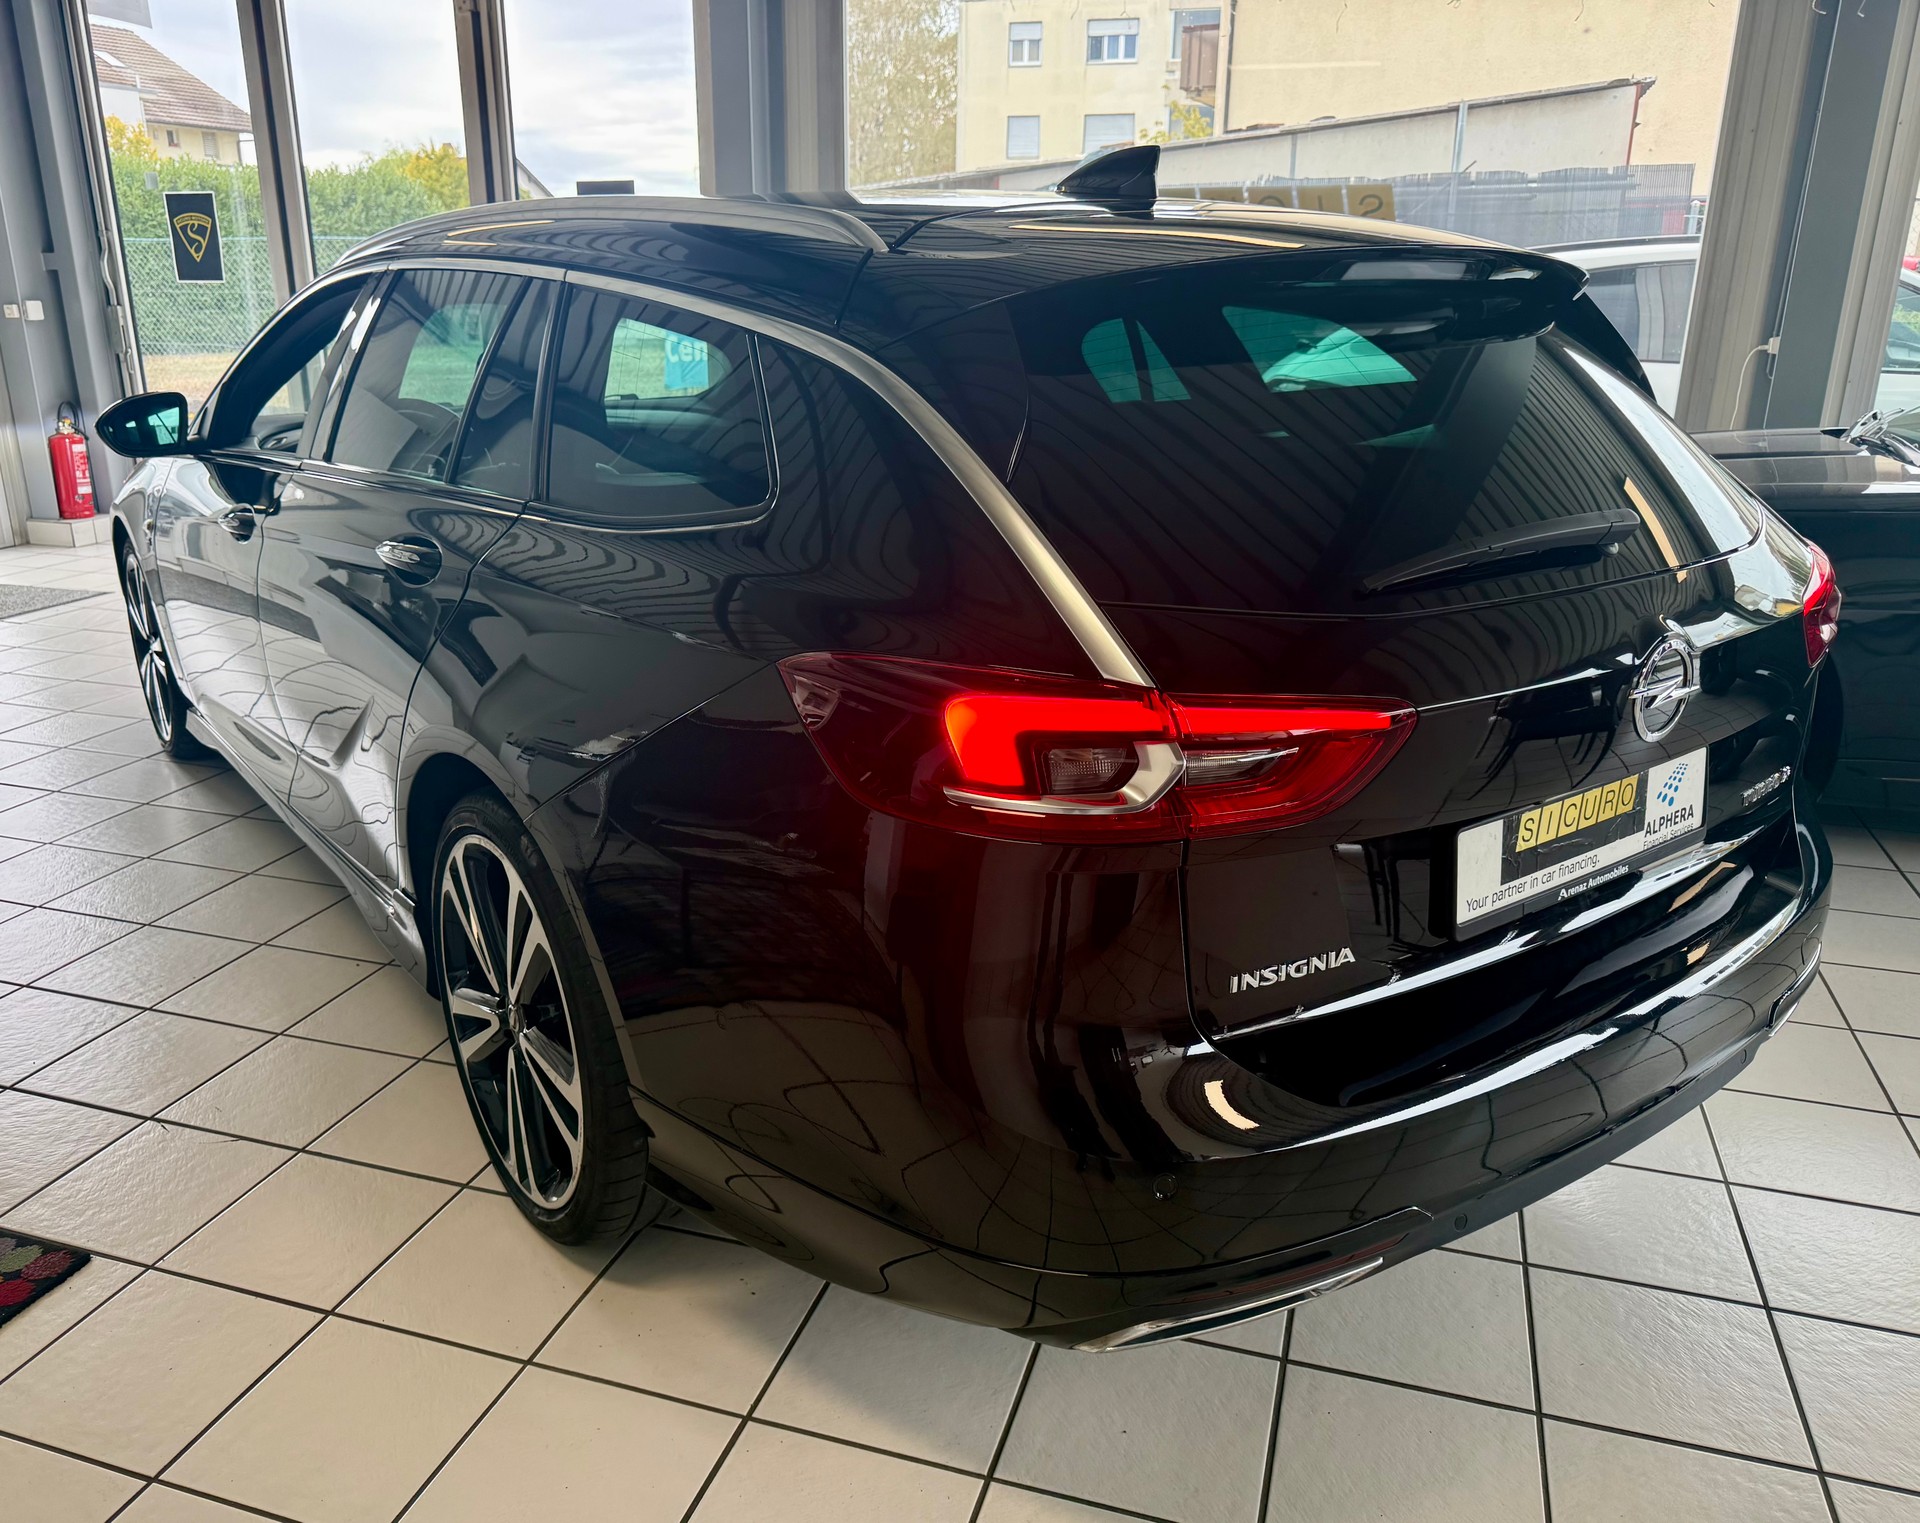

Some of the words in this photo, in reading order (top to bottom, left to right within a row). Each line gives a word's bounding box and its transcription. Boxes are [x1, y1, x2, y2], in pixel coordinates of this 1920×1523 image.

[1521, 782, 1635, 843] SICURO
[1644, 804, 1694, 838] ALPHERA
[1466, 895, 1489, 912] Your
[1491, 880, 1527, 906] partner
[1529, 875, 1539, 890] in
[1541, 870, 1556, 885] car
[1558, 852, 1600, 879] financing.
[1557, 883, 1587, 901] Arenaz
[1587, 864, 1629, 888] Automobiles
[1229, 947, 1356, 994] INSIGNIA
